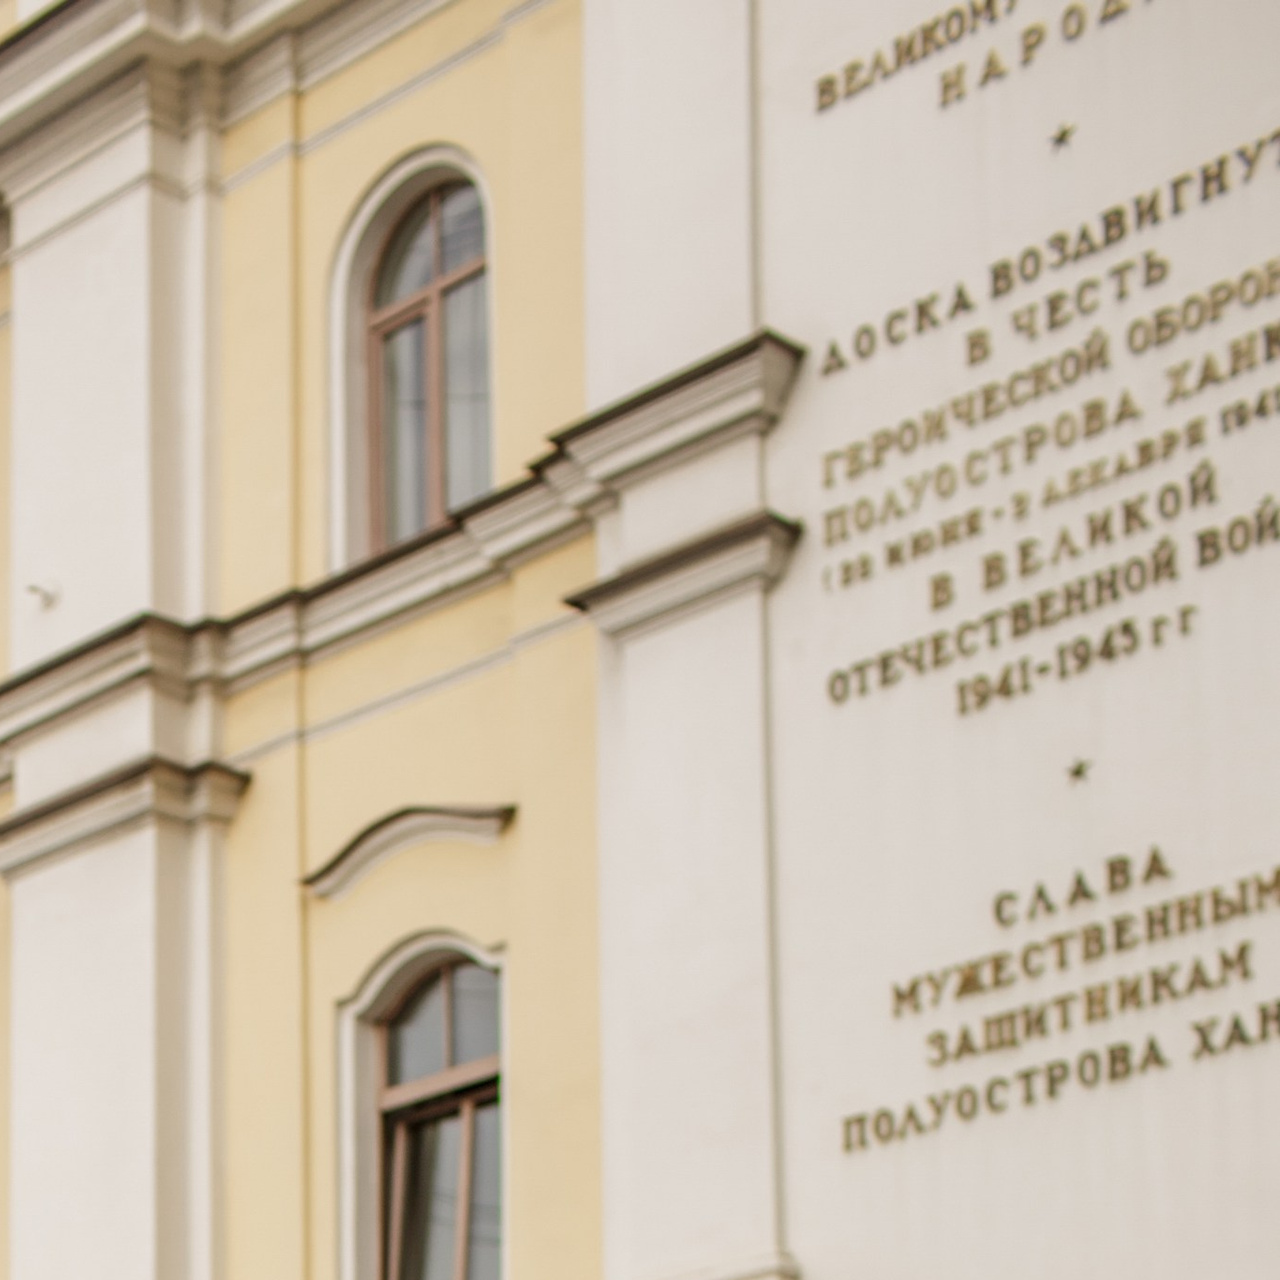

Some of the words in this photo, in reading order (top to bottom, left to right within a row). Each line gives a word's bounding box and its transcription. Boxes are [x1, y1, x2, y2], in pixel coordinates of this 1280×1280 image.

[940, 0, 1150, 108] НАРОД
[821, 284, 976, 377] ДОСКА
[967, 330, 991, 366] В
[1012, 250, 1170, 341] ЧЕСТЬ
[823, 328, 1111, 488] ГЕРОИЧЕСКОЙ
[824, 391, 1142, 548] ПОЛУОСТРОВА
[929, 573, 955, 612] В
[982, 459, 1218, 593] ВЕЛИКОЙ
[827, 536, 1179, 706] ОТЕЧЕСТВЕННОЙ
[993, 846, 1172, 929] СЛАВА
[843, 1036, 1170, 1153] ПОЛУОСТРОВА
